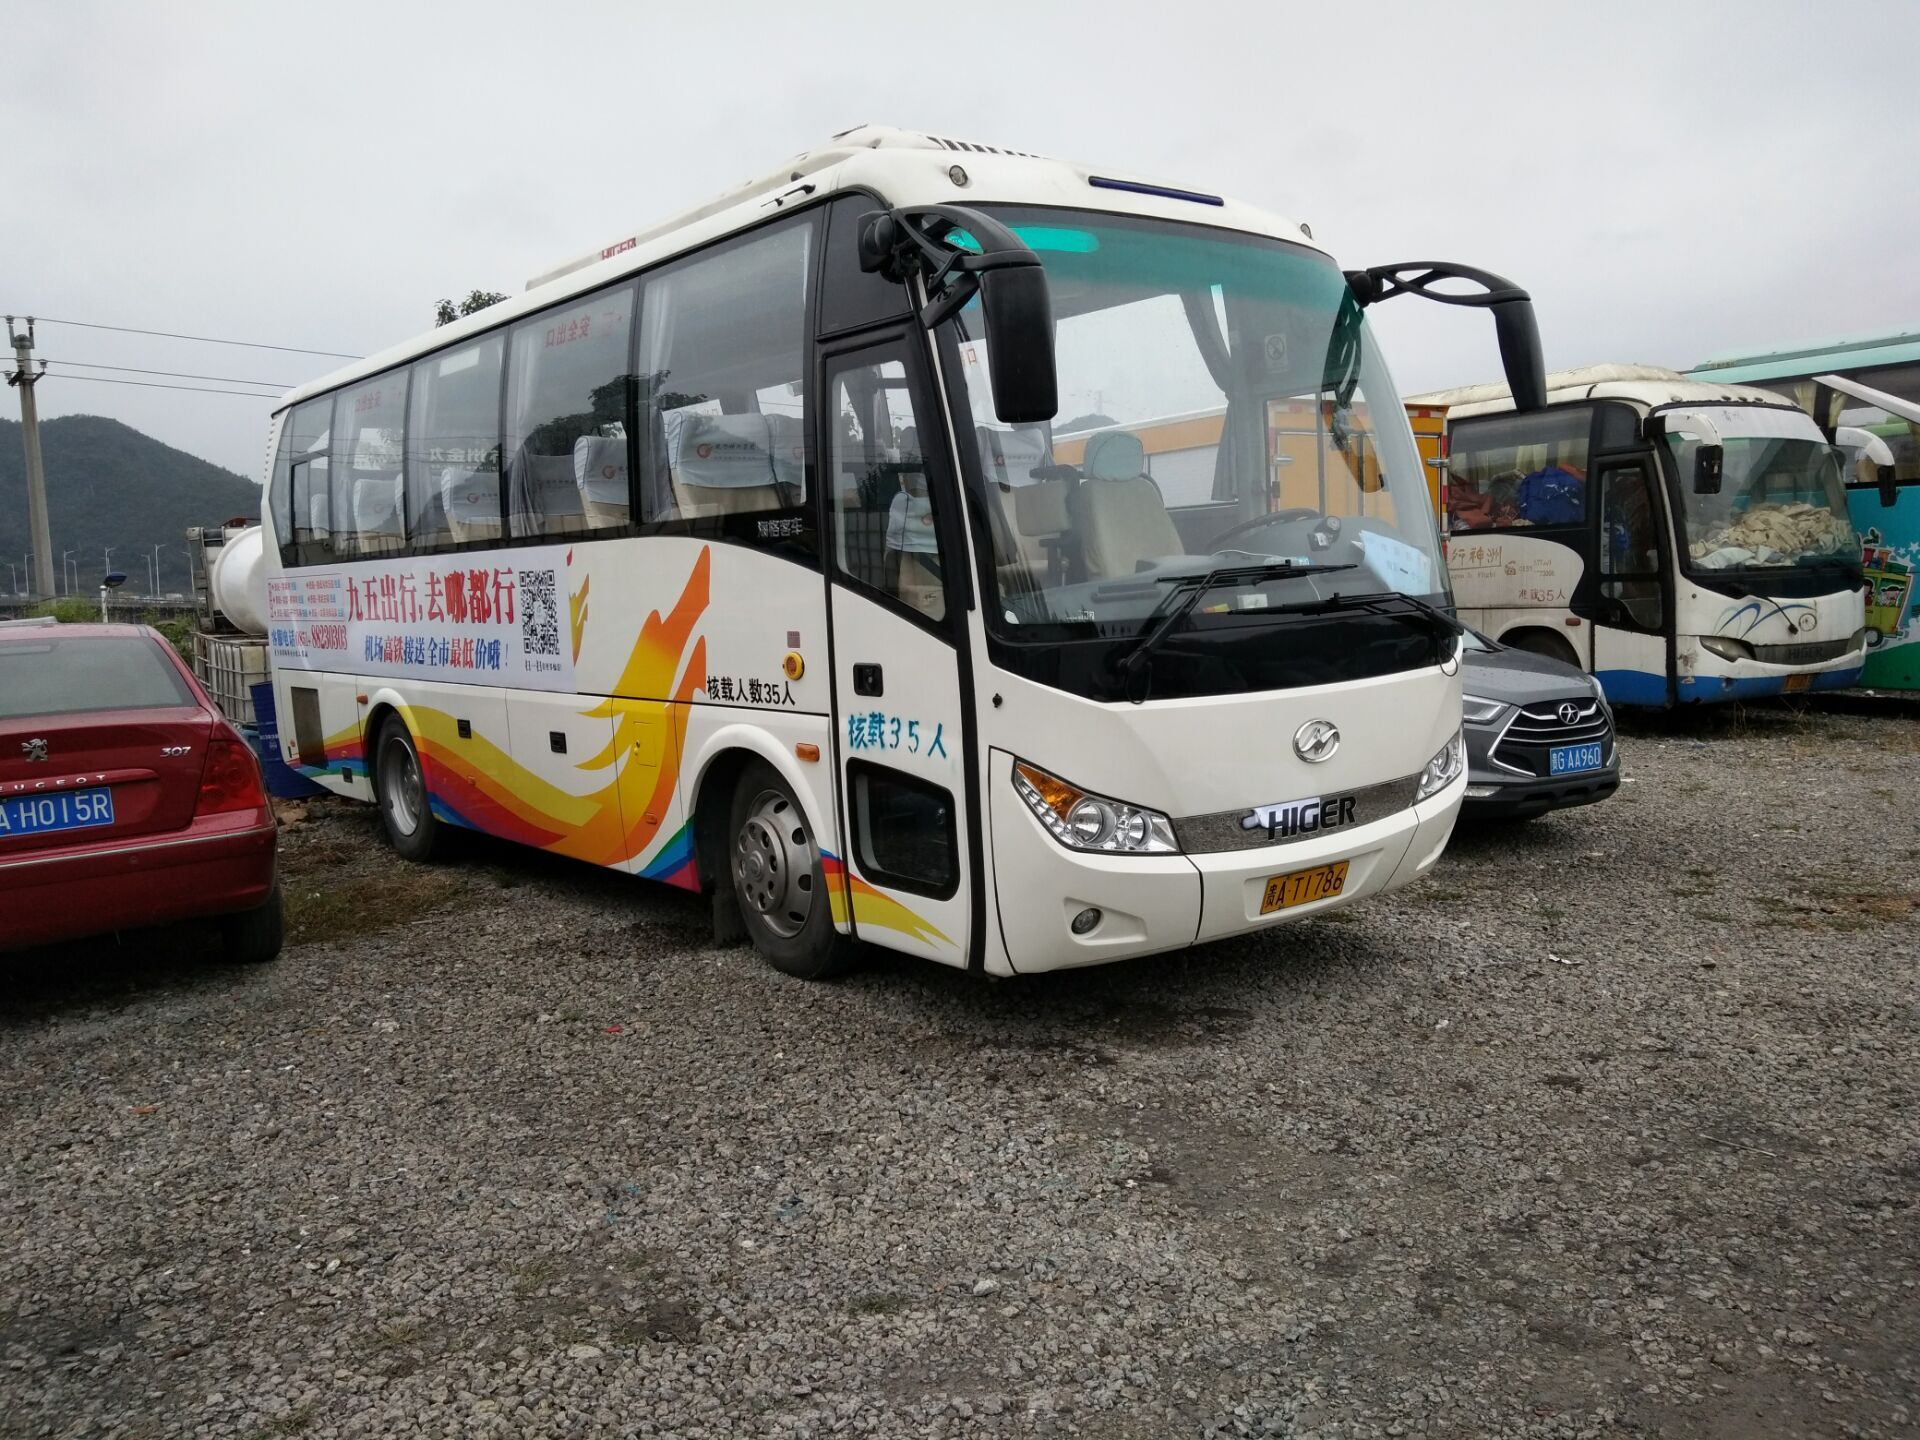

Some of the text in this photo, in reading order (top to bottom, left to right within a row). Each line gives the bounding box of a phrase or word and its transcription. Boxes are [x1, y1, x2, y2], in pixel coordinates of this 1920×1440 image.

[707, 676, 796, 706] 核载人数35人
[160, 746, 191, 758] 307
[848, 711, 947, 759] 核载35人
[1268, 796, 1356, 841] HIGER
